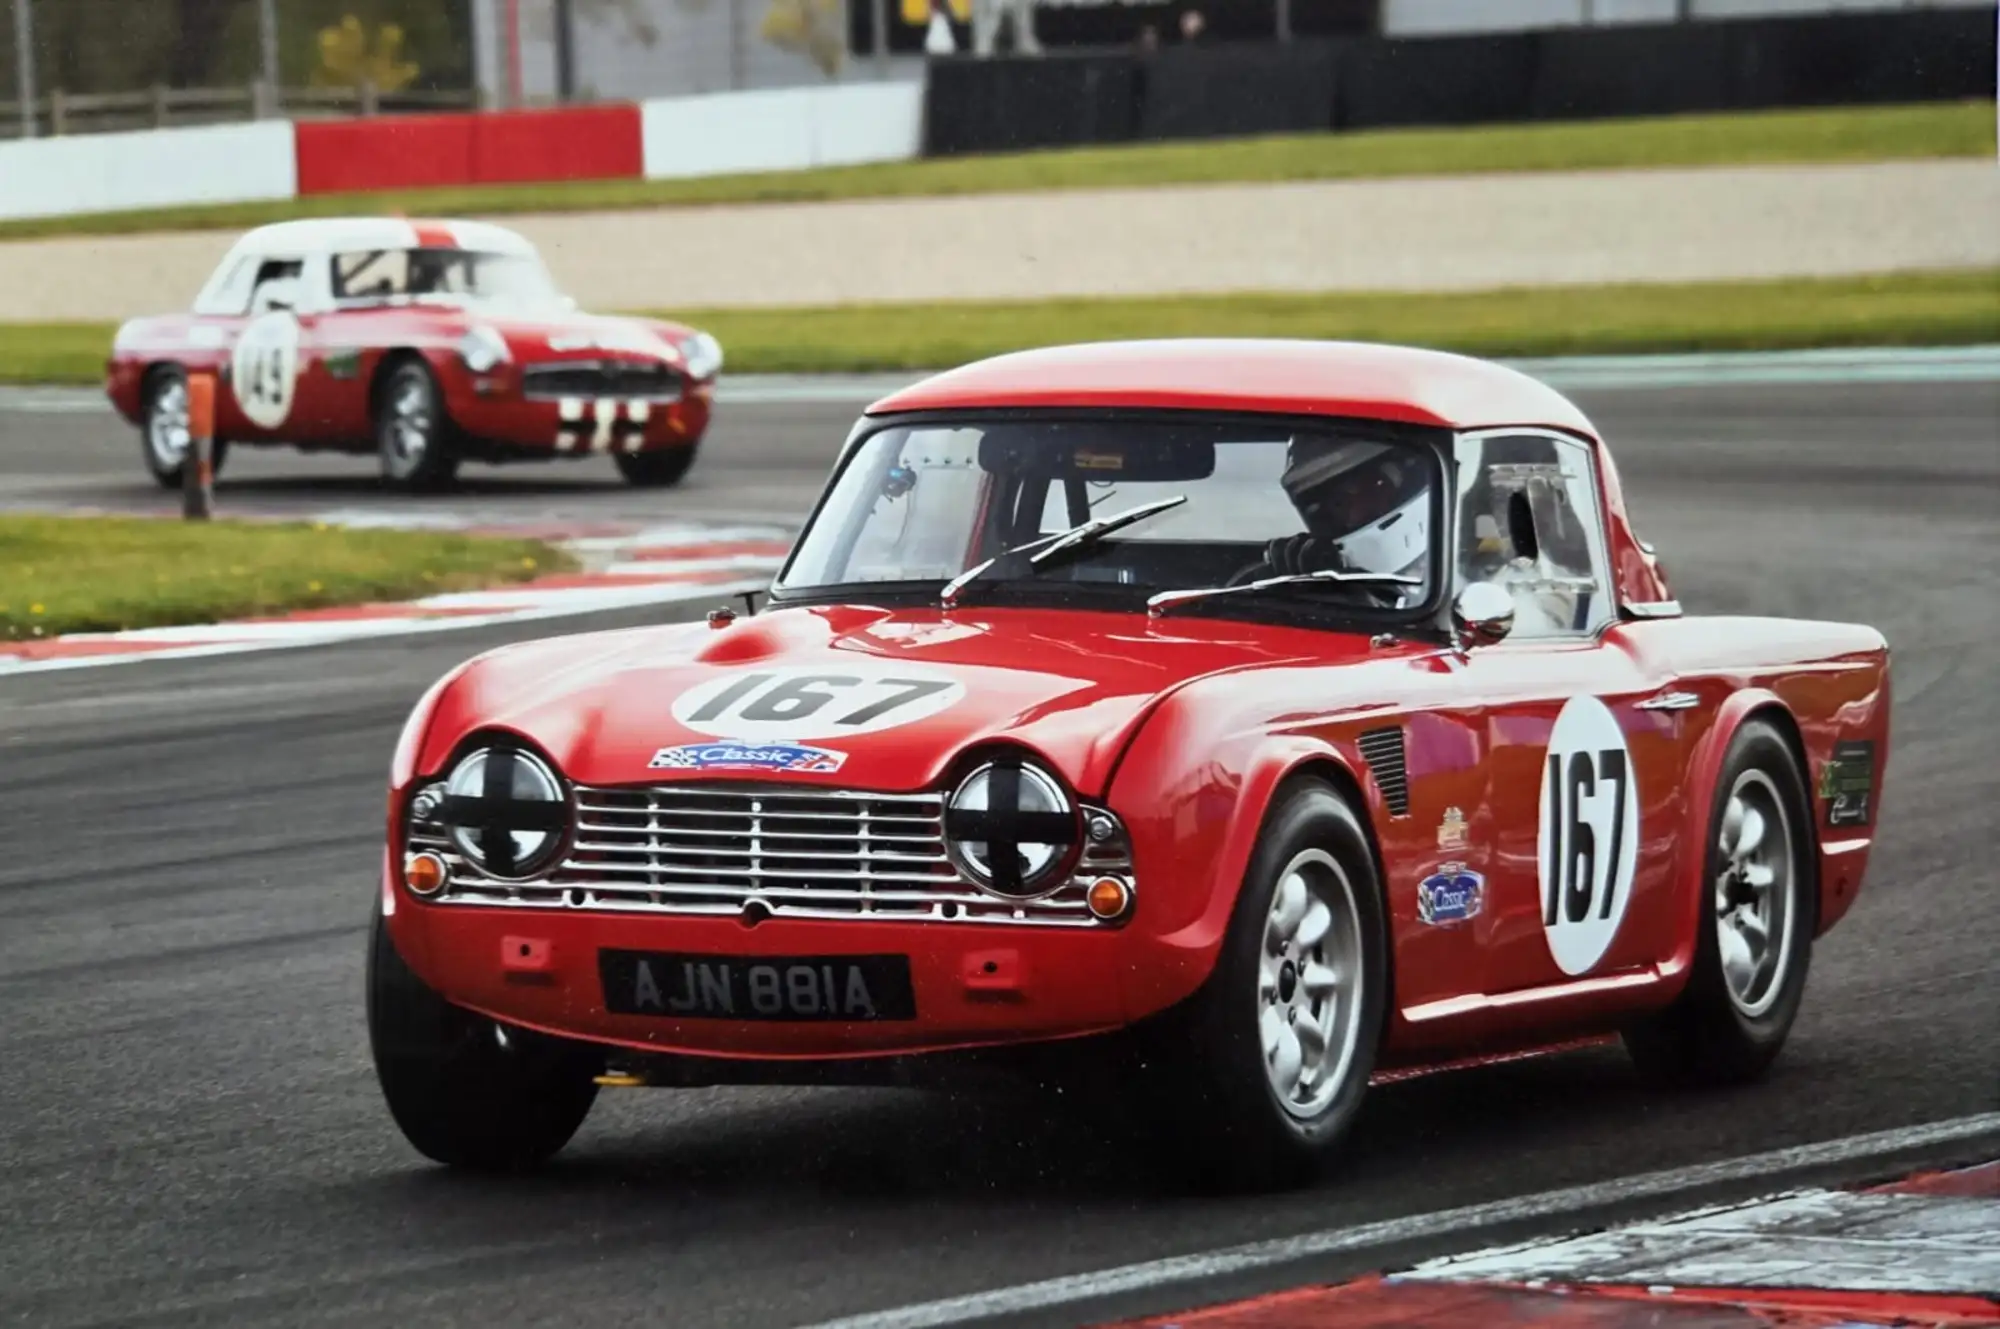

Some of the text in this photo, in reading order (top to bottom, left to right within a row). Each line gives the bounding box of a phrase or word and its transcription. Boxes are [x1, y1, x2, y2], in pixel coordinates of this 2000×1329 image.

[686, 673, 956, 725] 167
[700, 747, 793, 763] Classic
[1545, 748, 1627, 927] 167
[634, 959, 876, 1018] AJN 881A
